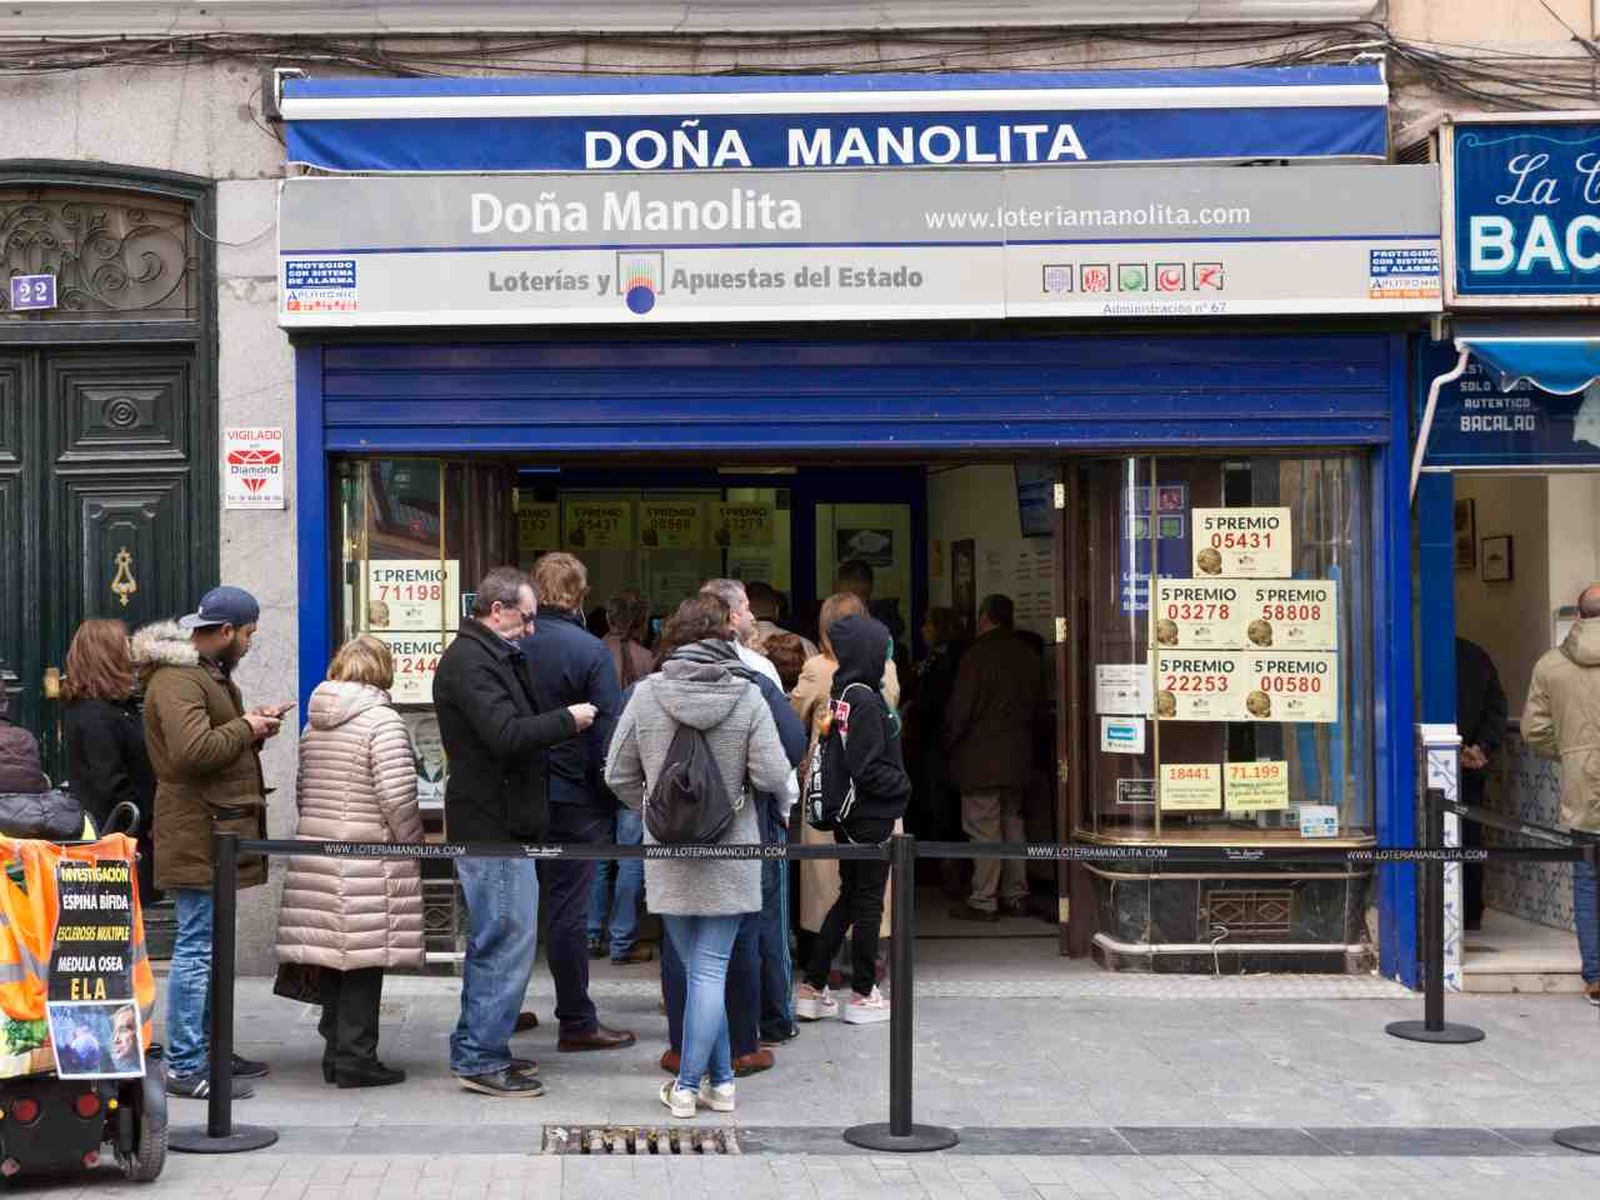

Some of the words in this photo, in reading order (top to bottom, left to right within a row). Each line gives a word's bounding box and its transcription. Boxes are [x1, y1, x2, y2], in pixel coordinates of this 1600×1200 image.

[584, 119, 751, 169] DOÑA
[788, 123, 1087, 165] MANOLITA
[1496, 154, 1560, 204] La
[470, 192, 588, 233] Doña
[602, 188, 802, 231] Manolita
[925, 204, 1250, 230] www.loteriamanolita.com
[488, 270, 589, 292] Loterías
[597, 274, 610, 295] y
[671, 269, 785, 295] Apuestas
[794, 266, 831, 288] del
[839, 266, 922, 288] Estado
[20, 282, 47, 302] 22
[1211, 302, 1226, 313] 67
[1460, 381, 1492, 392] SOLO
[1460, 415, 1536, 432] BACALAO
[228, 430, 282, 440] VIGILADO
[1217, 517, 1280, 529] PREMIO
[1211, 532, 1271, 549] 05431
[385, 570, 448, 582] PREMIO
[379, 585, 441, 601] 71198
[1174, 588, 1237, 601] PREMIO
[1268, 589, 1327, 601] PREMIO
[1168, 604, 1230, 620] 03278
[1262, 605, 1321, 620] 58808
[392, 658, 438, 673] 1244
[1173, 660, 1235, 672] PREMIO
[1267, 661, 1328, 673] PREMIO
[1166, 675, 1229, 692] 22253
[1261, 676, 1321, 692] 00580
[324, 844, 466, 856] WWW.LOTERIAMANOLITA.COM
[646, 846, 787, 858] WWW.LOTERIAMANOLITA.COM
[1027, 847, 1168, 858] WWW.LOTERIAMANOLITA.COM
[1347, 849, 1488, 860] WWW.LOTERIAMANOLITA.COM
[62, 894, 97, 910] ESPINA
[57, 926, 96, 941] ESCLEROSIS
[98, 955, 124, 971] OSEA
